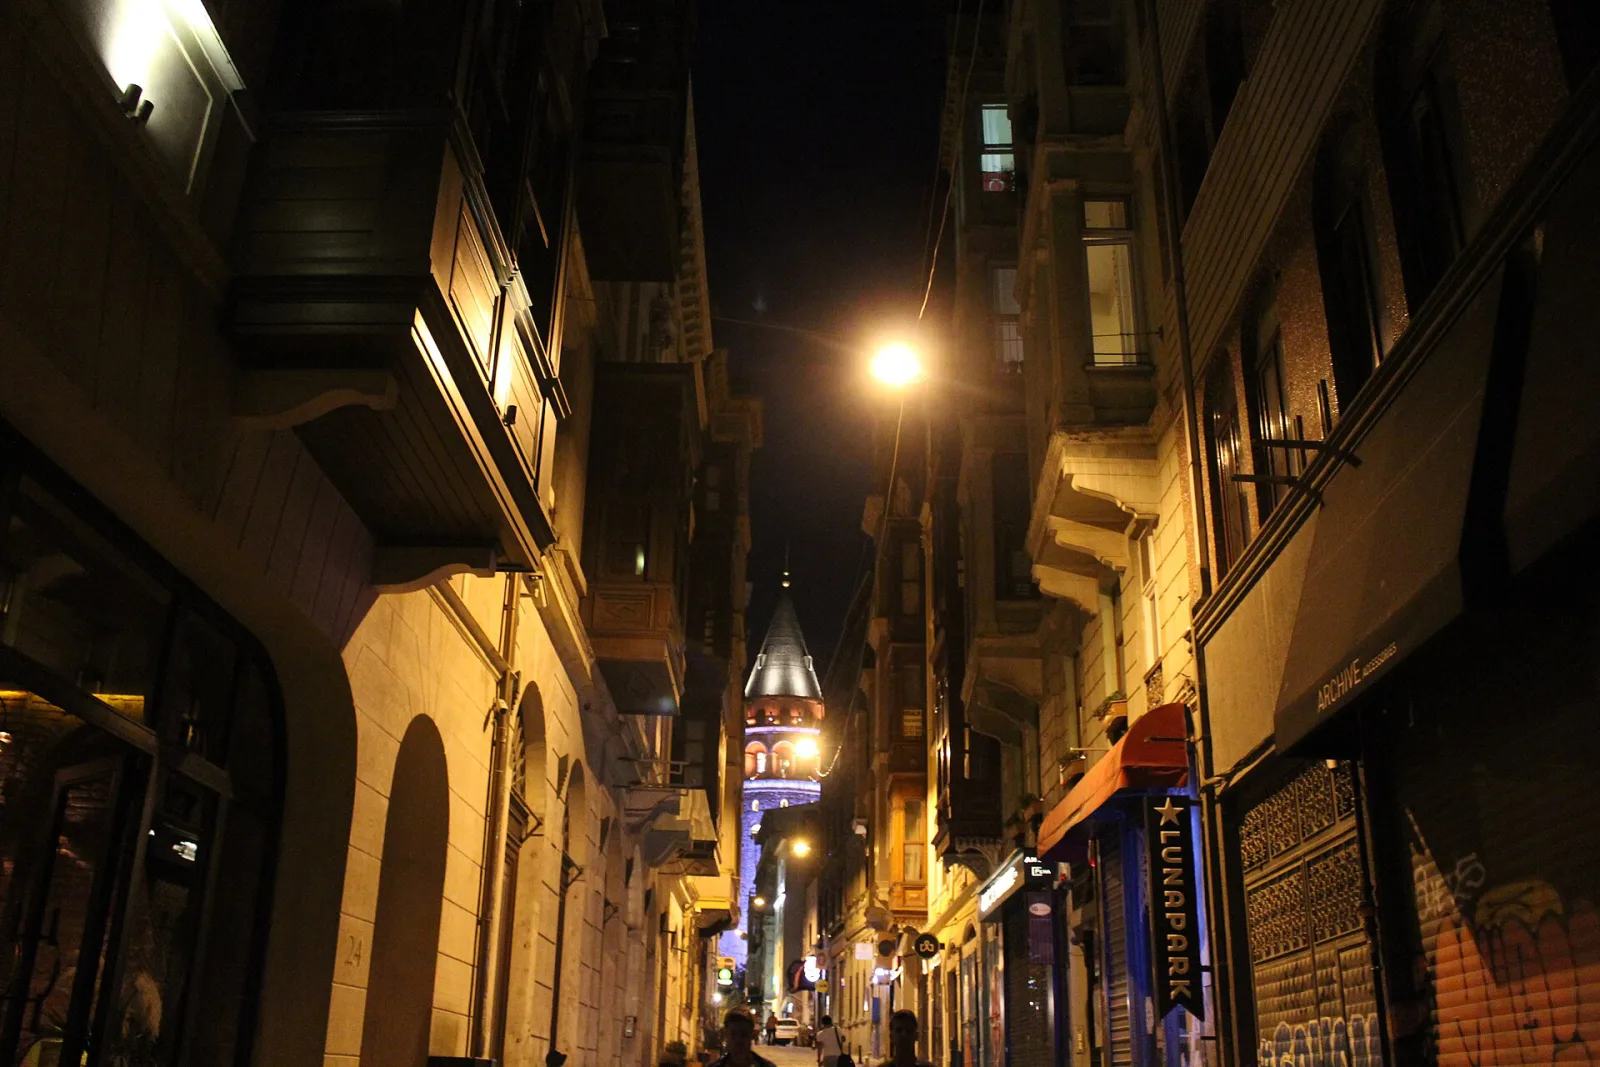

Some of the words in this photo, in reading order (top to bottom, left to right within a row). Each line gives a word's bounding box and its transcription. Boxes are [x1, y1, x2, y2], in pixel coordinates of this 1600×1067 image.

[1317, 658, 1361, 713] ARCHIVE
[1160, 831, 1192, 1000] LUNAPARK
[344, 935, 362, 967] 24
